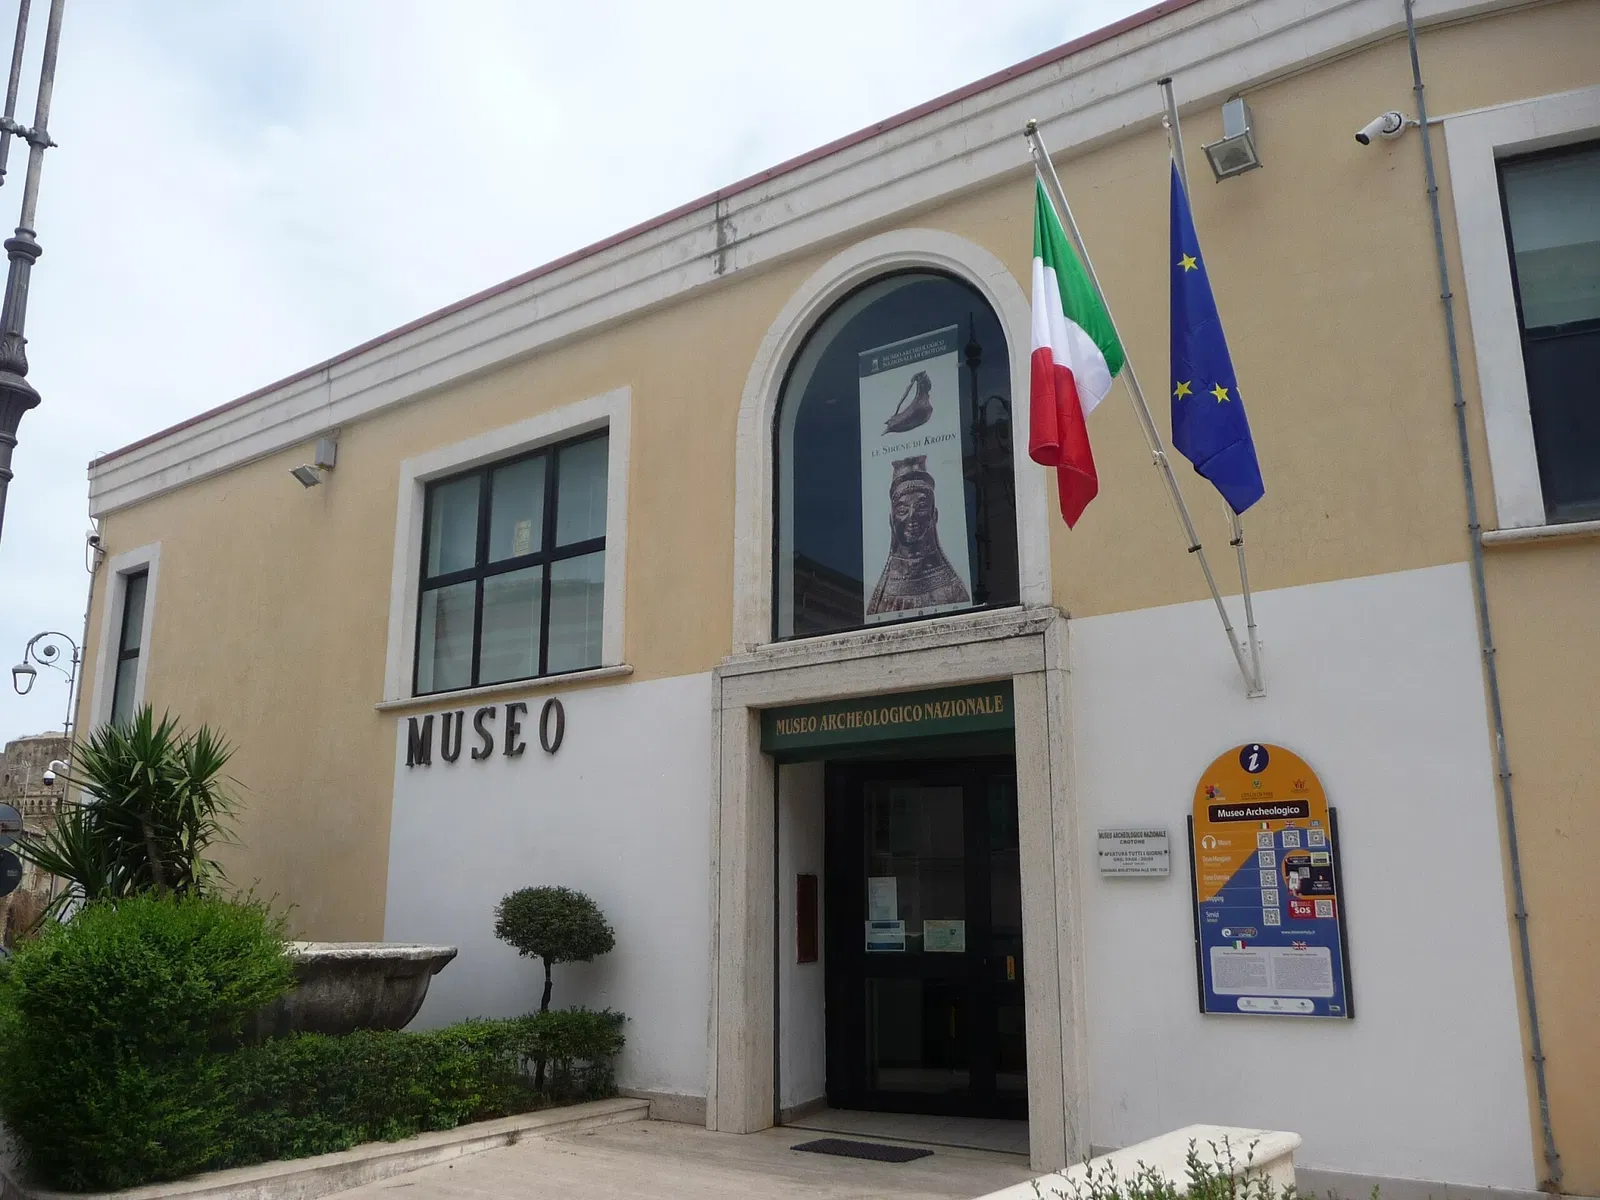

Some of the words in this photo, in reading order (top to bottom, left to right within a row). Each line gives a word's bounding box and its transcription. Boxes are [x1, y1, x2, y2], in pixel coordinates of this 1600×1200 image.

[871, 448, 881, 458] LE
[913, 440, 922, 449] DI
[923, 432, 957, 446] KROTON
[775, 715, 817, 736] MUSEO
[819, 704, 922, 732] ARCHEOLOGICO
[924, 694, 1004, 720] NAZIONALE
[405, 697, 565, 767] MUSEO
[1217, 809, 1245, 818] Museo
[1245, 806, 1300, 816] Archeologico
[1098, 831, 1112, 839] MUSEO
[1113, 831, 1143, 839] ARCHEOLOGICO
[1144, 830, 1166, 838] NAZIONALE
[1294, 906, 1311, 914] SOS
